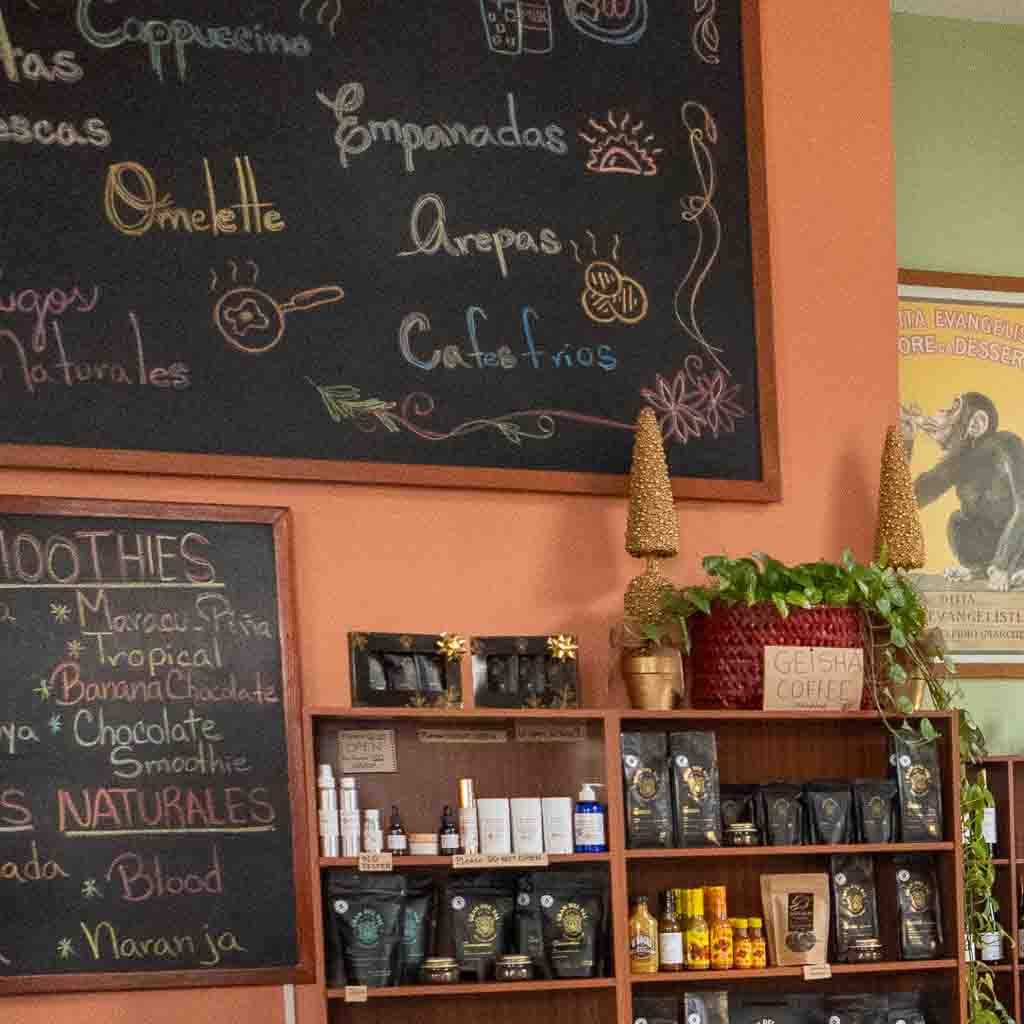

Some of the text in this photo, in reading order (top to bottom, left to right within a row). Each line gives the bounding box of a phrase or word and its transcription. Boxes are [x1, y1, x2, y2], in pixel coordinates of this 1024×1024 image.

[316, 82, 568, 171] Empanadas
[397, 193, 563, 277] Arepas
[82, 631, 223, 677] Tropical
[771, 650, 863, 674] GEISHA
[72, 706, 224, 747] Chocolate
[109, 744, 251, 778] Smoothie
[57, 785, 277, 833] NATURALES
[105, 843, 225, 902] Blood
[80, 921, 250, 967] Naranja
